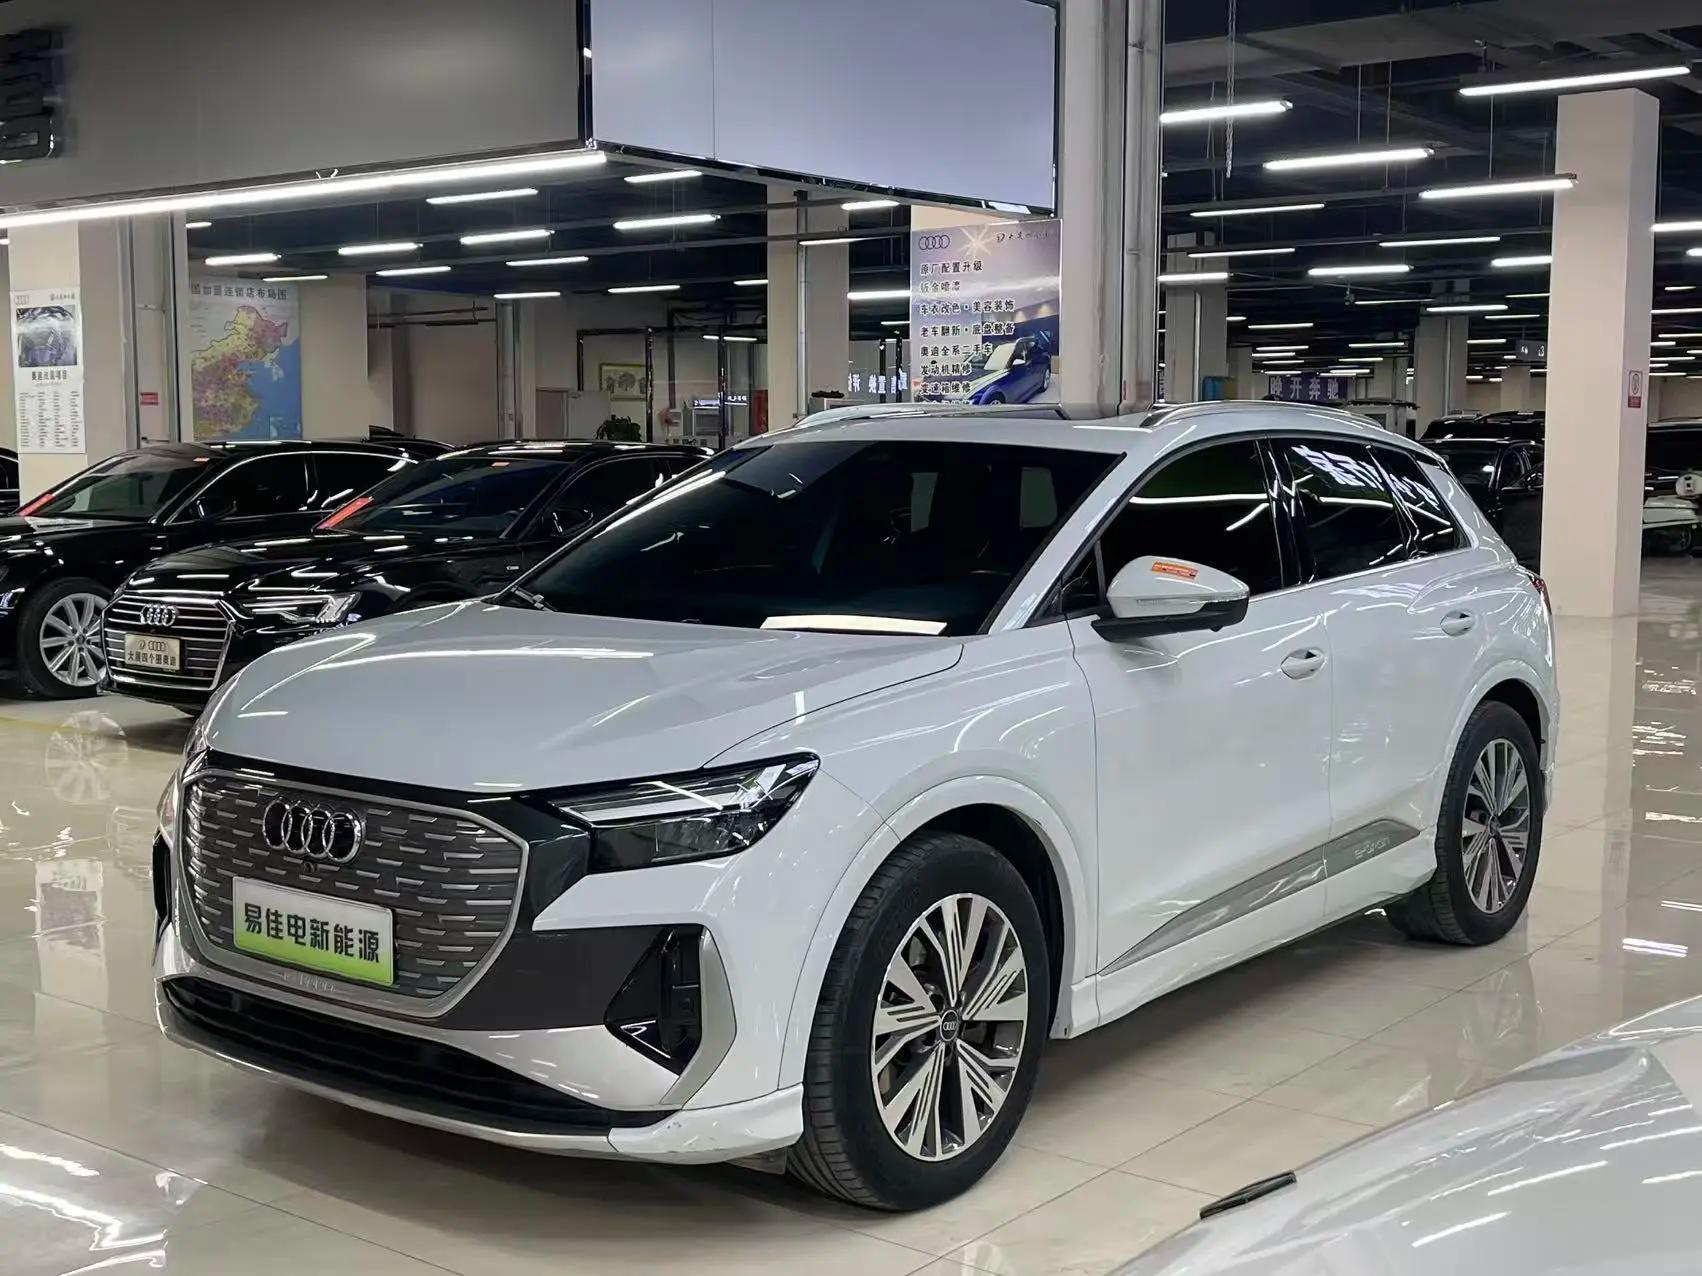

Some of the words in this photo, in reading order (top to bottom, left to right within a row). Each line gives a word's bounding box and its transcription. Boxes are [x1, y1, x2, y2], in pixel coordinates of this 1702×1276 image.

[920, 260, 983, 275] 原厂配置升级
[920, 343, 993, 357] 奥迪全系二手车
[920, 363, 972, 376] 发动机精修
[920, 382, 971, 394] 变速箱维修
[244, 902, 380, 963] 易佳电新能源
